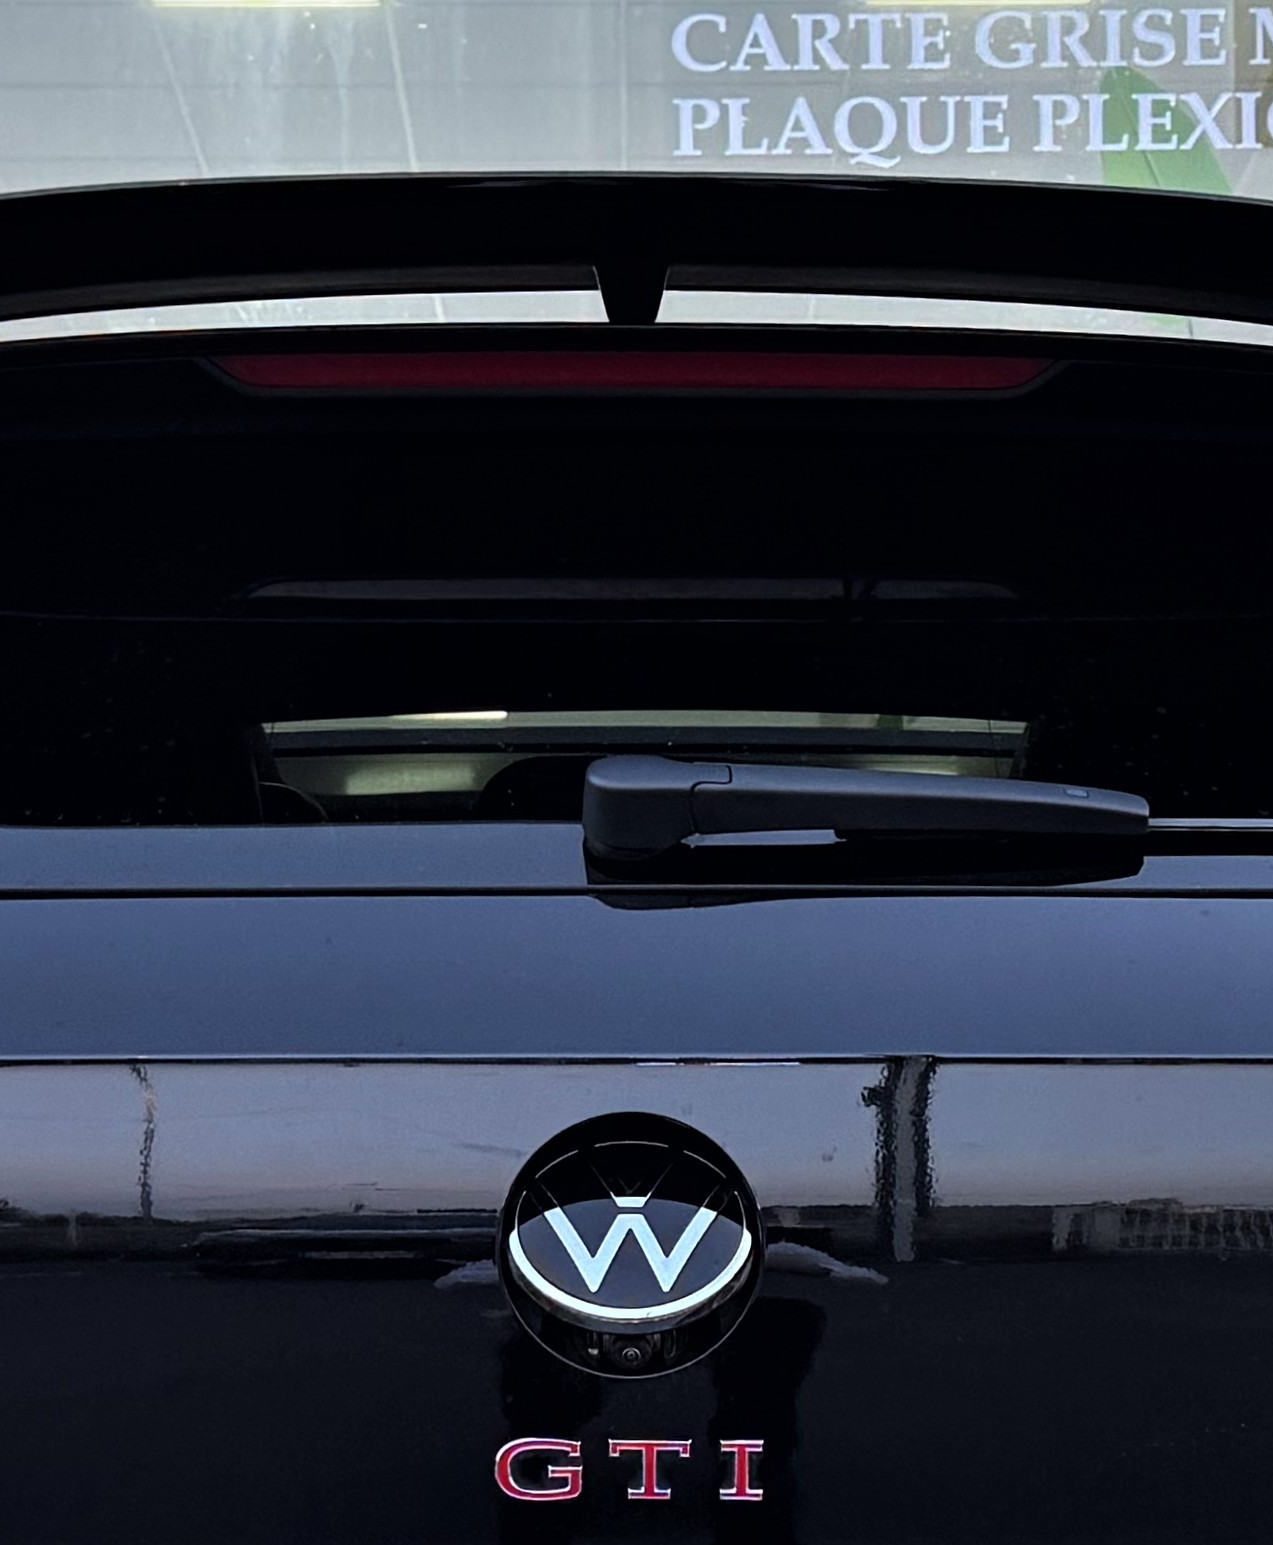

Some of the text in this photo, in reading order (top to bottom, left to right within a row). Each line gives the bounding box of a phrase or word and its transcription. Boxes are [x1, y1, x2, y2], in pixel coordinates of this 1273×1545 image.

[671, 12, 952, 72] CARTE
[975, 8, 1227, 68] GRISE
[672, 95, 1011, 168] PLAQUE
[495, 1437, 765, 1501] GTI
